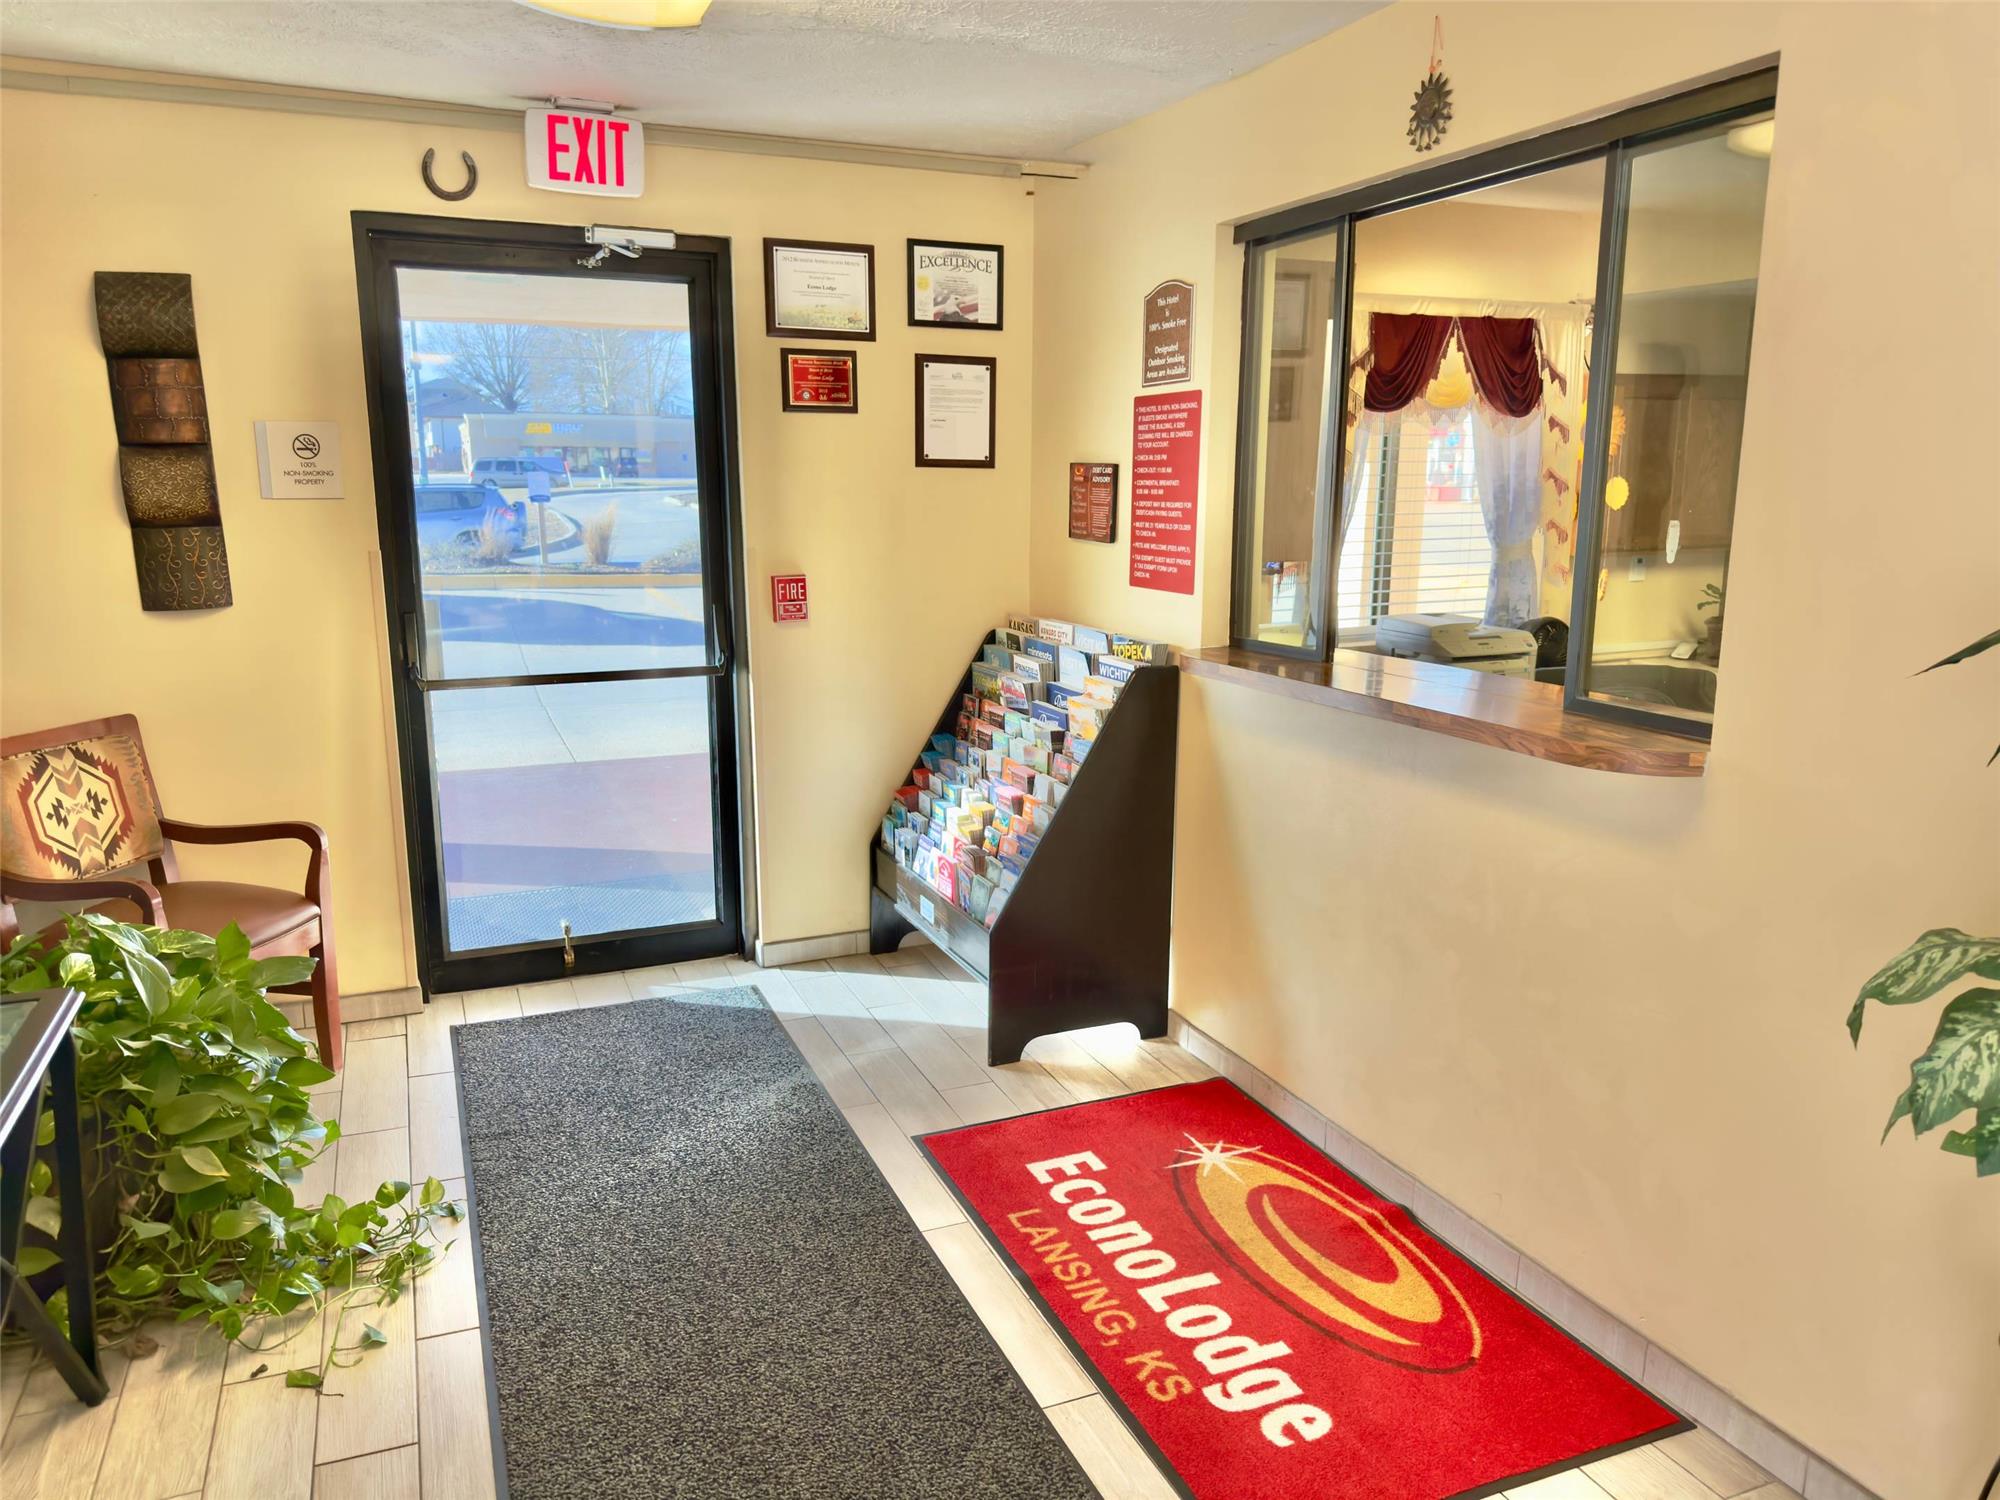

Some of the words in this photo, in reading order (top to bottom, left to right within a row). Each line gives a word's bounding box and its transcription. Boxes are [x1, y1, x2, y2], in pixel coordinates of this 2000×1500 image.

[547, 114, 629, 187] EXIT
[920, 254, 993, 274] EXCELLENCE
[1157, 298, 1166, 308] This
[1166, 293, 1180, 305] Hotel
[1149, 322, 1161, 333] 100%
[1161, 319, 1176, 331] Smoke
[1176, 318, 1187, 328] Free
[1154, 341, 1179, 356] Designated
[1147, 357, 1166, 368] Outdoor
[1166, 353, 1185, 367] Smoking
[1146, 370, 1158, 379] Areas
[1166, 364, 1187, 376] Available
[778, 582, 805, 600] FIRE
[1008, 618, 1034, 634] KANSAS
[1027, 646, 1053, 662] minnesota
[1112, 643, 1153, 662] TOPEKA
[1007, 1208, 1137, 1346] LANSING,
[1124, 1350, 1195, 1402] KS
[1025, 1150, 1333, 1448] EconoLodge
